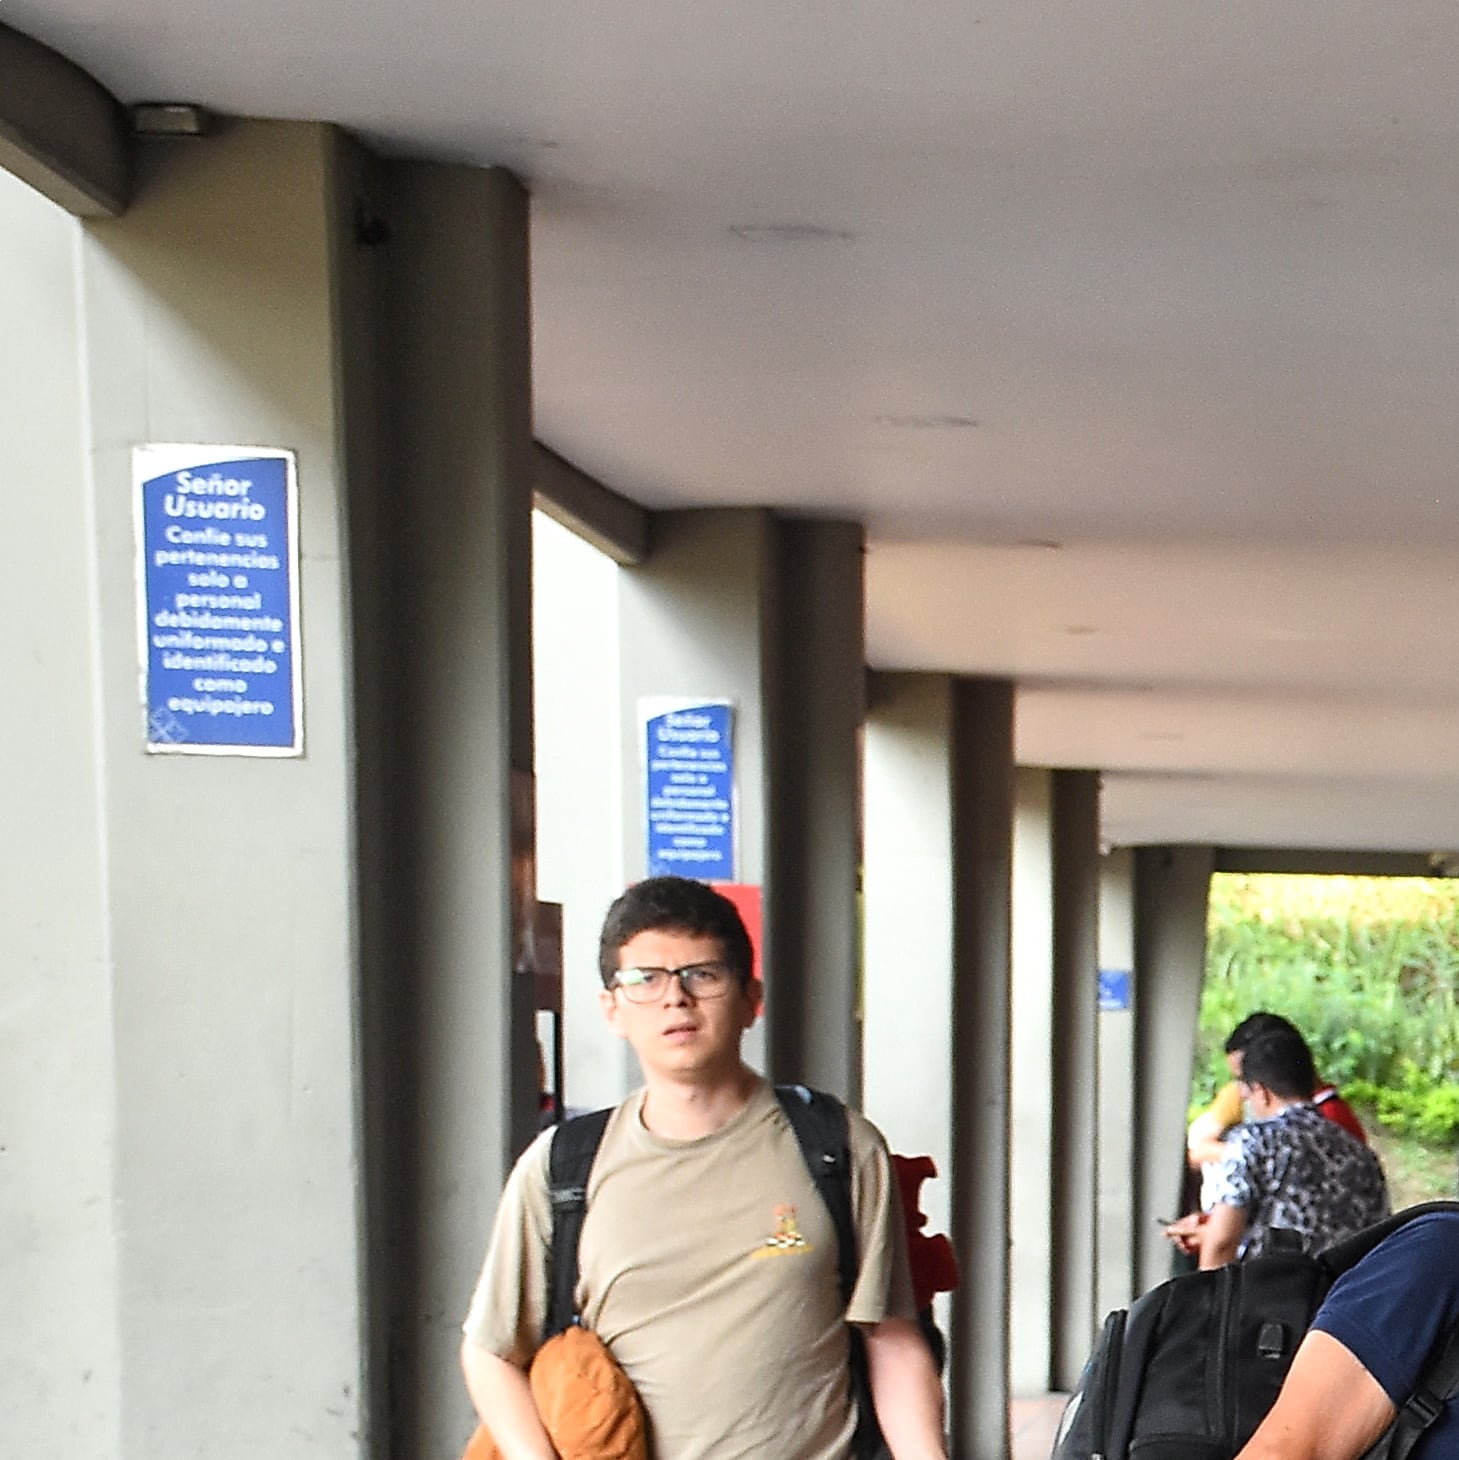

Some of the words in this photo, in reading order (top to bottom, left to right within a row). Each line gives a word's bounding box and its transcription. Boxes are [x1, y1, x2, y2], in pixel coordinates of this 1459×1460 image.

[175, 471, 252, 496] Señor
[164, 494, 266, 521] Usuario
[235, 534, 268, 549] sus
[155, 550, 280, 570] pertenencias
[234, 575, 248, 589] a
[175, 591, 262, 611] personal
[154, 610, 283, 632] debidamente
[153, 630, 268, 652] uniformado
[271, 639, 285, 653] e
[163, 652, 278, 674] identificado
[193, 678, 248, 693] como
[167, 695, 274, 717] equipajero
